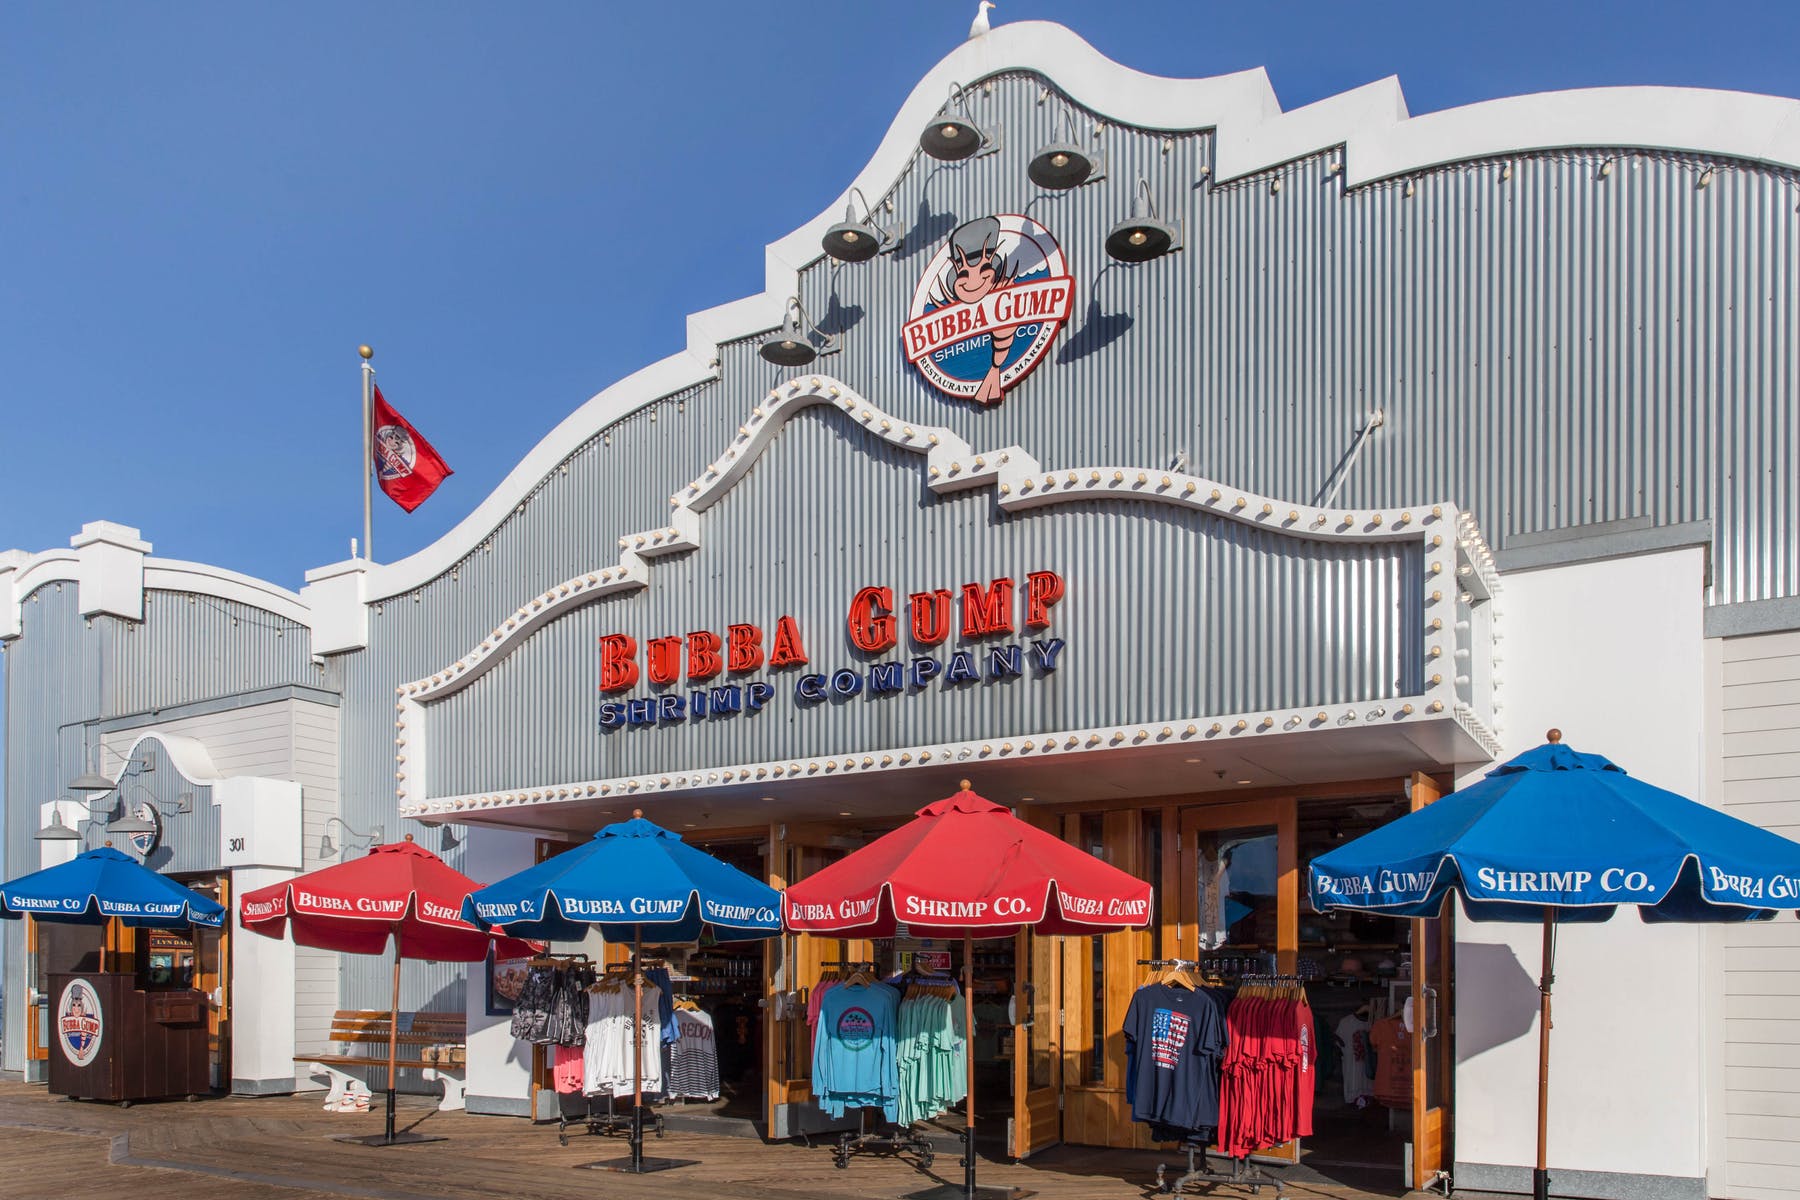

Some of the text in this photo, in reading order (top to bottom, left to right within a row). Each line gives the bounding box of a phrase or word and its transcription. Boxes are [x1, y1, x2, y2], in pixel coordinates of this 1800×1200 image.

[909, 287, 1066, 354] BUBBA GUMP
[920, 324, 1052, 393] RESTAURANT & MARKET
[935, 334, 992, 363] SHRIMP
[600, 570, 1065, 692] BUBBA GUMP
[599, 638, 1065, 729] SHRIMP COMPANY
[229, 838, 244, 852] 301
[1316, 869, 1435, 896] BUBBA GUMP
[1478, 867, 1656, 893] SHRIMP CO.
[1768, 874, 1800, 898] GU
[12, 896, 60, 908] SHRIMP
[103, 900, 181, 913] BUBBA GUMP
[298, 892, 353, 911] BUBBA
[357, 898, 404, 912] GUMP
[422, 901, 461, 921] SHRI
[476, 902, 518, 917] SHRIMP
[564, 897, 684, 915] BUBBA GUMP
[706, 900, 780, 923] SHRIMP CO.
[790, 896, 876, 921] BUBBA GUMP
[906, 895, 1032, 917] SHRIMP CO.
[1060, 891, 1147, 916] BUBBA GUMP
